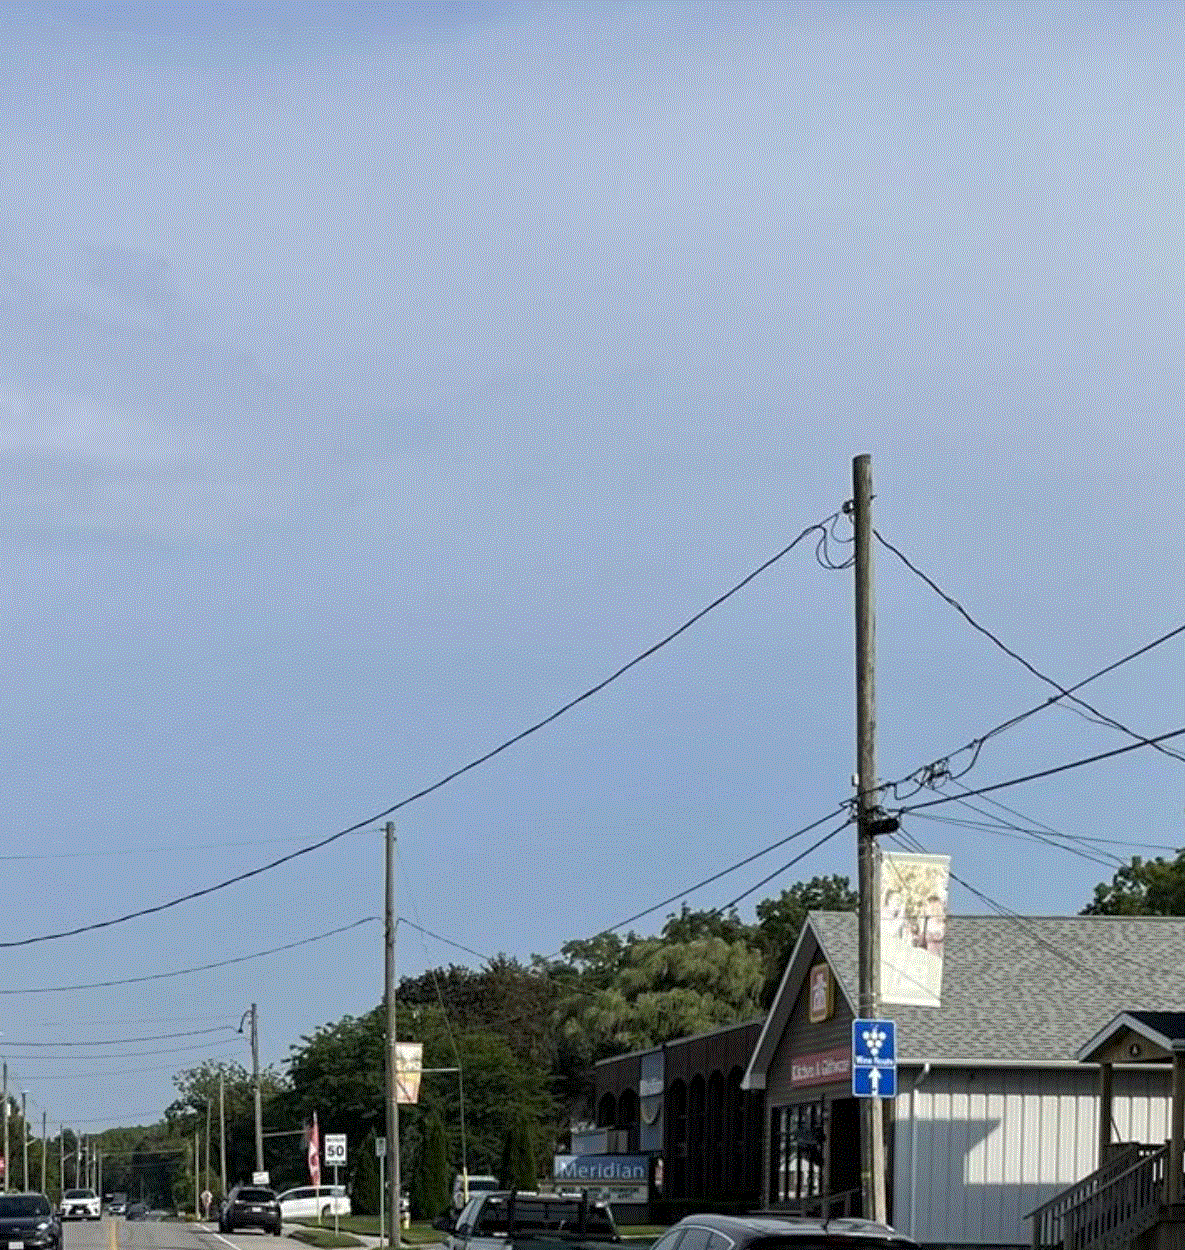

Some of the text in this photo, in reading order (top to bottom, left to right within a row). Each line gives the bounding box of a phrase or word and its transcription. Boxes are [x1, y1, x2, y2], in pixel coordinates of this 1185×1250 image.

[856, 1055, 872, 1063] Wine
[327, 1145, 344, 1157] 50
[559, 1161, 644, 1178] Meridian
